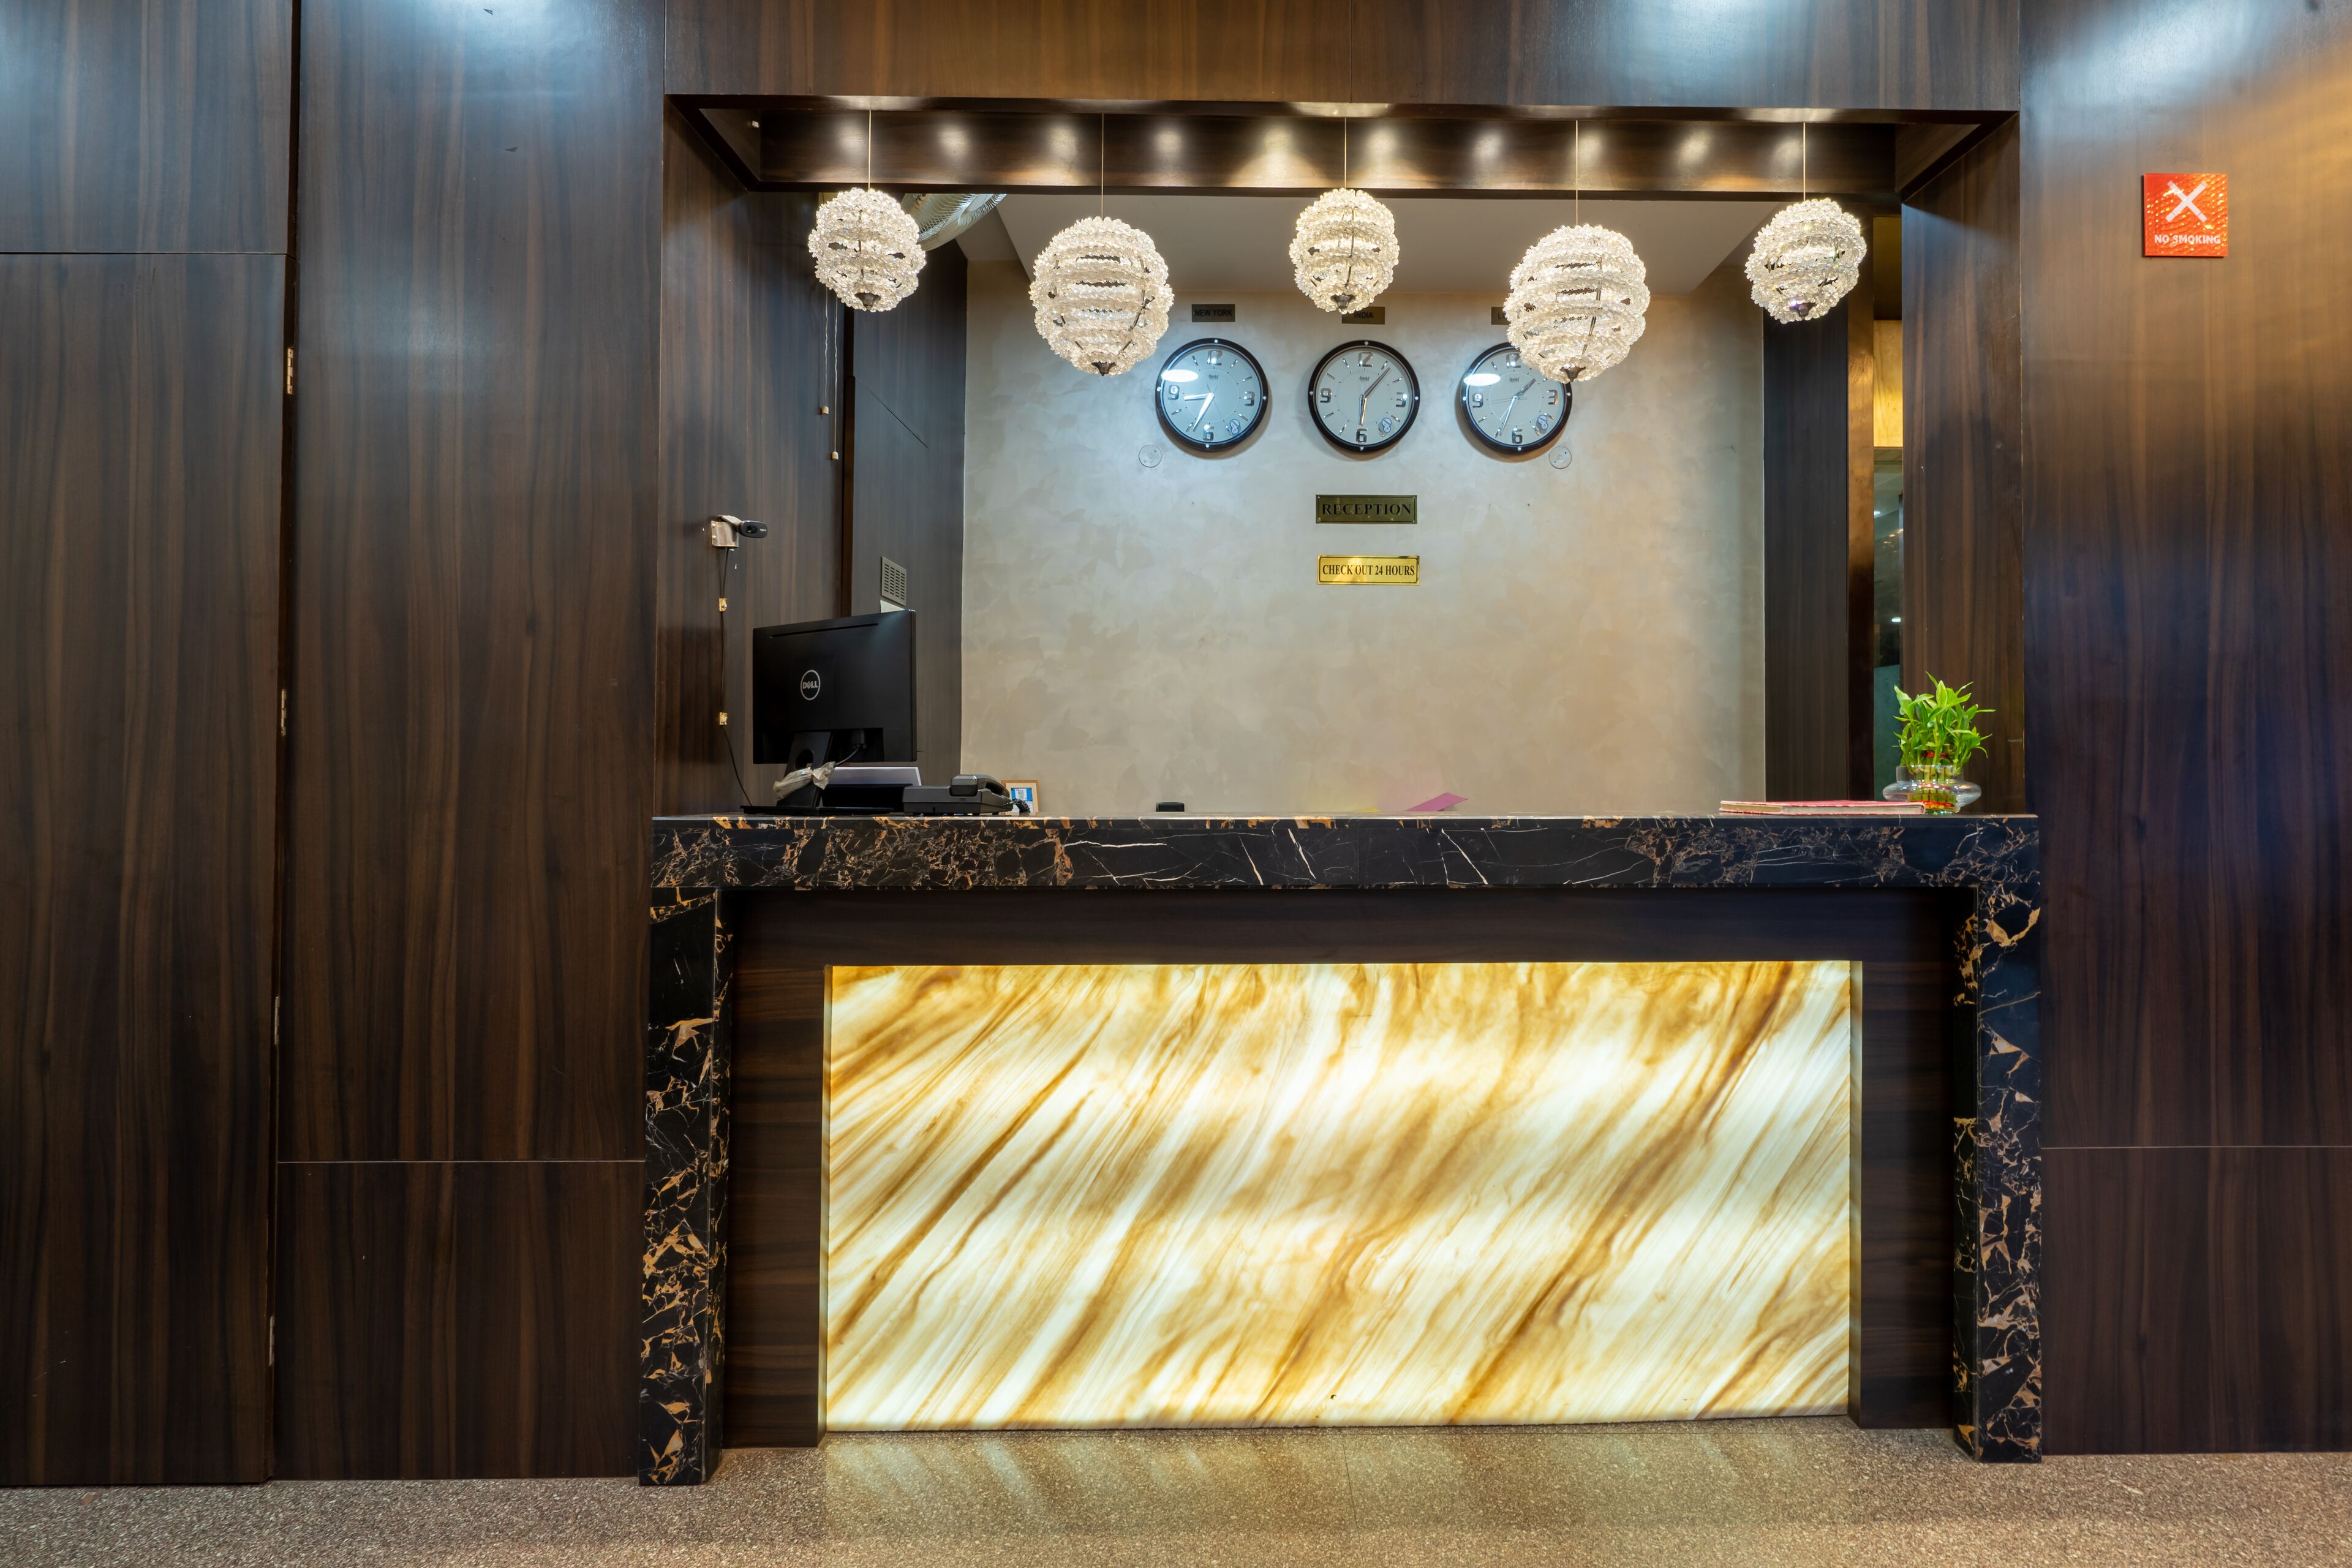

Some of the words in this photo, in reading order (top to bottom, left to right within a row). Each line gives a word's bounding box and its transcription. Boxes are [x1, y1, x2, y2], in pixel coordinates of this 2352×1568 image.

[2154, 235, 2169, 244] NO
[2173, 235, 2221, 244] SMOKING
[1194, 309, 1211, 317] NEW
[1213, 309, 1233, 317] YORK
[1207, 350, 1223, 366] 12
[1357, 352, 1373, 368] 12
[1167, 385, 1180, 401] 9
[1244, 391, 1255, 407] 3
[1320, 388, 1332, 403] 9
[1396, 392, 1407, 408] 3
[1472, 392, 1483, 409] 9
[1547, 390, 1558, 405] 3
[1203, 424, 1215, 441] 6
[1356, 428, 1368, 443] 6
[1512, 428, 1523, 445] 6
[1322, 504, 1411, 515] RECEPTION
[1322, 565, 1353, 575] CHECK
[1355, 565, 1373, 576] OUT
[1374, 565, 1384, 576] 24
[1385, 565, 1415, 576] HOURS
